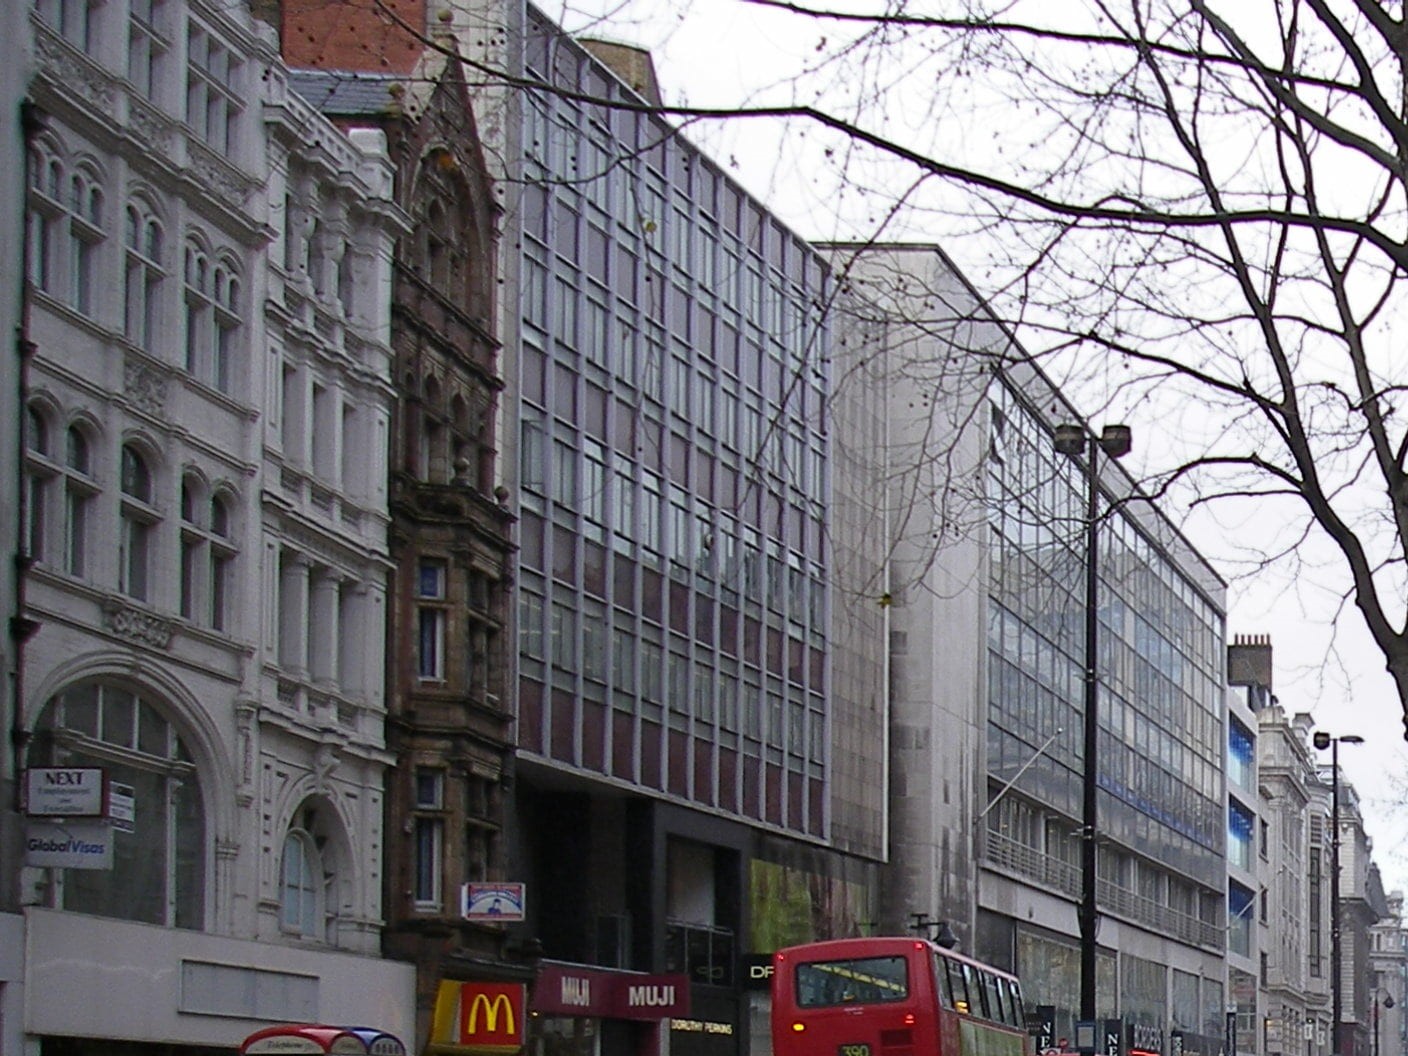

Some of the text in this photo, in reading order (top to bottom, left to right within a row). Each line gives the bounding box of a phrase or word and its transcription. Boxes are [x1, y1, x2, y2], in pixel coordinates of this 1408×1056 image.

[45, 771, 83, 785] NEXT
[561, 976, 590, 1007] MUJI
[628, 985, 675, 1007] MUJI
